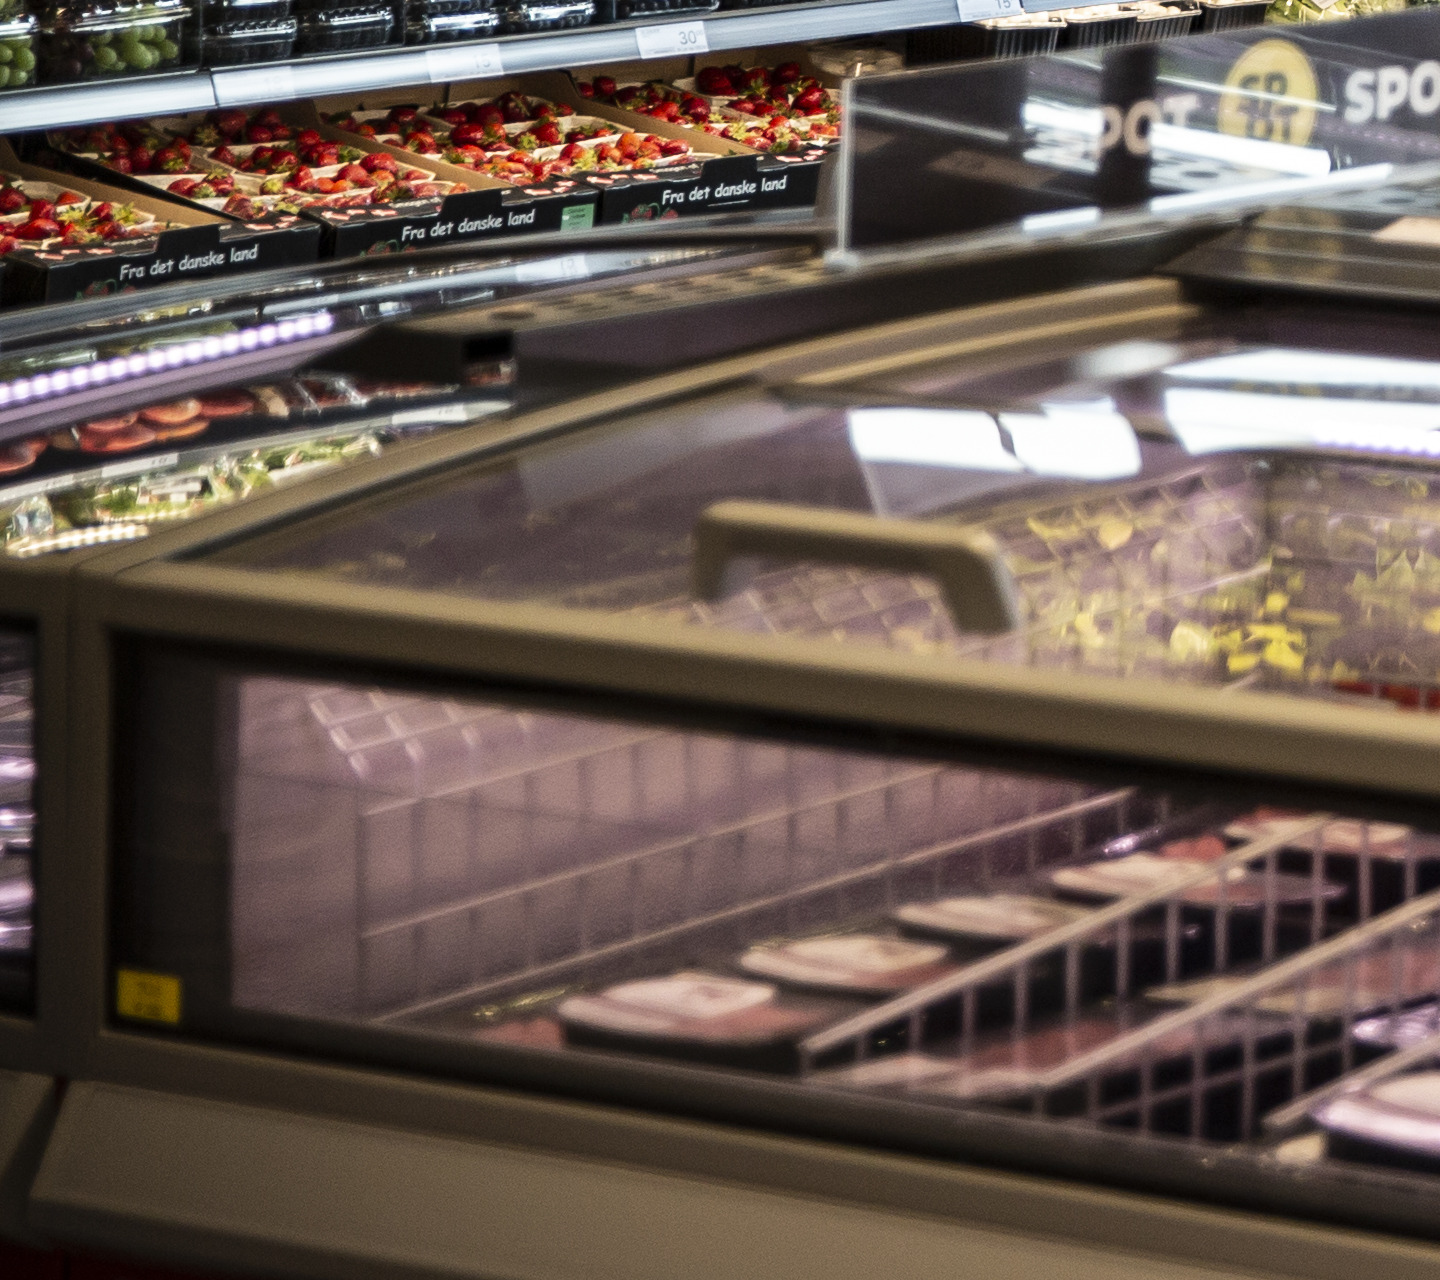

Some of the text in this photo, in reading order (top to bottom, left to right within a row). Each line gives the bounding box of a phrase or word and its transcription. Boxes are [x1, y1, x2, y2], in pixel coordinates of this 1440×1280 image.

[1097, 92, 1199, 156] POT
[662, 175, 788, 206] Fra det danske land
[401, 208, 536, 242] Fra det danske land
[119, 244, 258, 282] Fra det danske land
